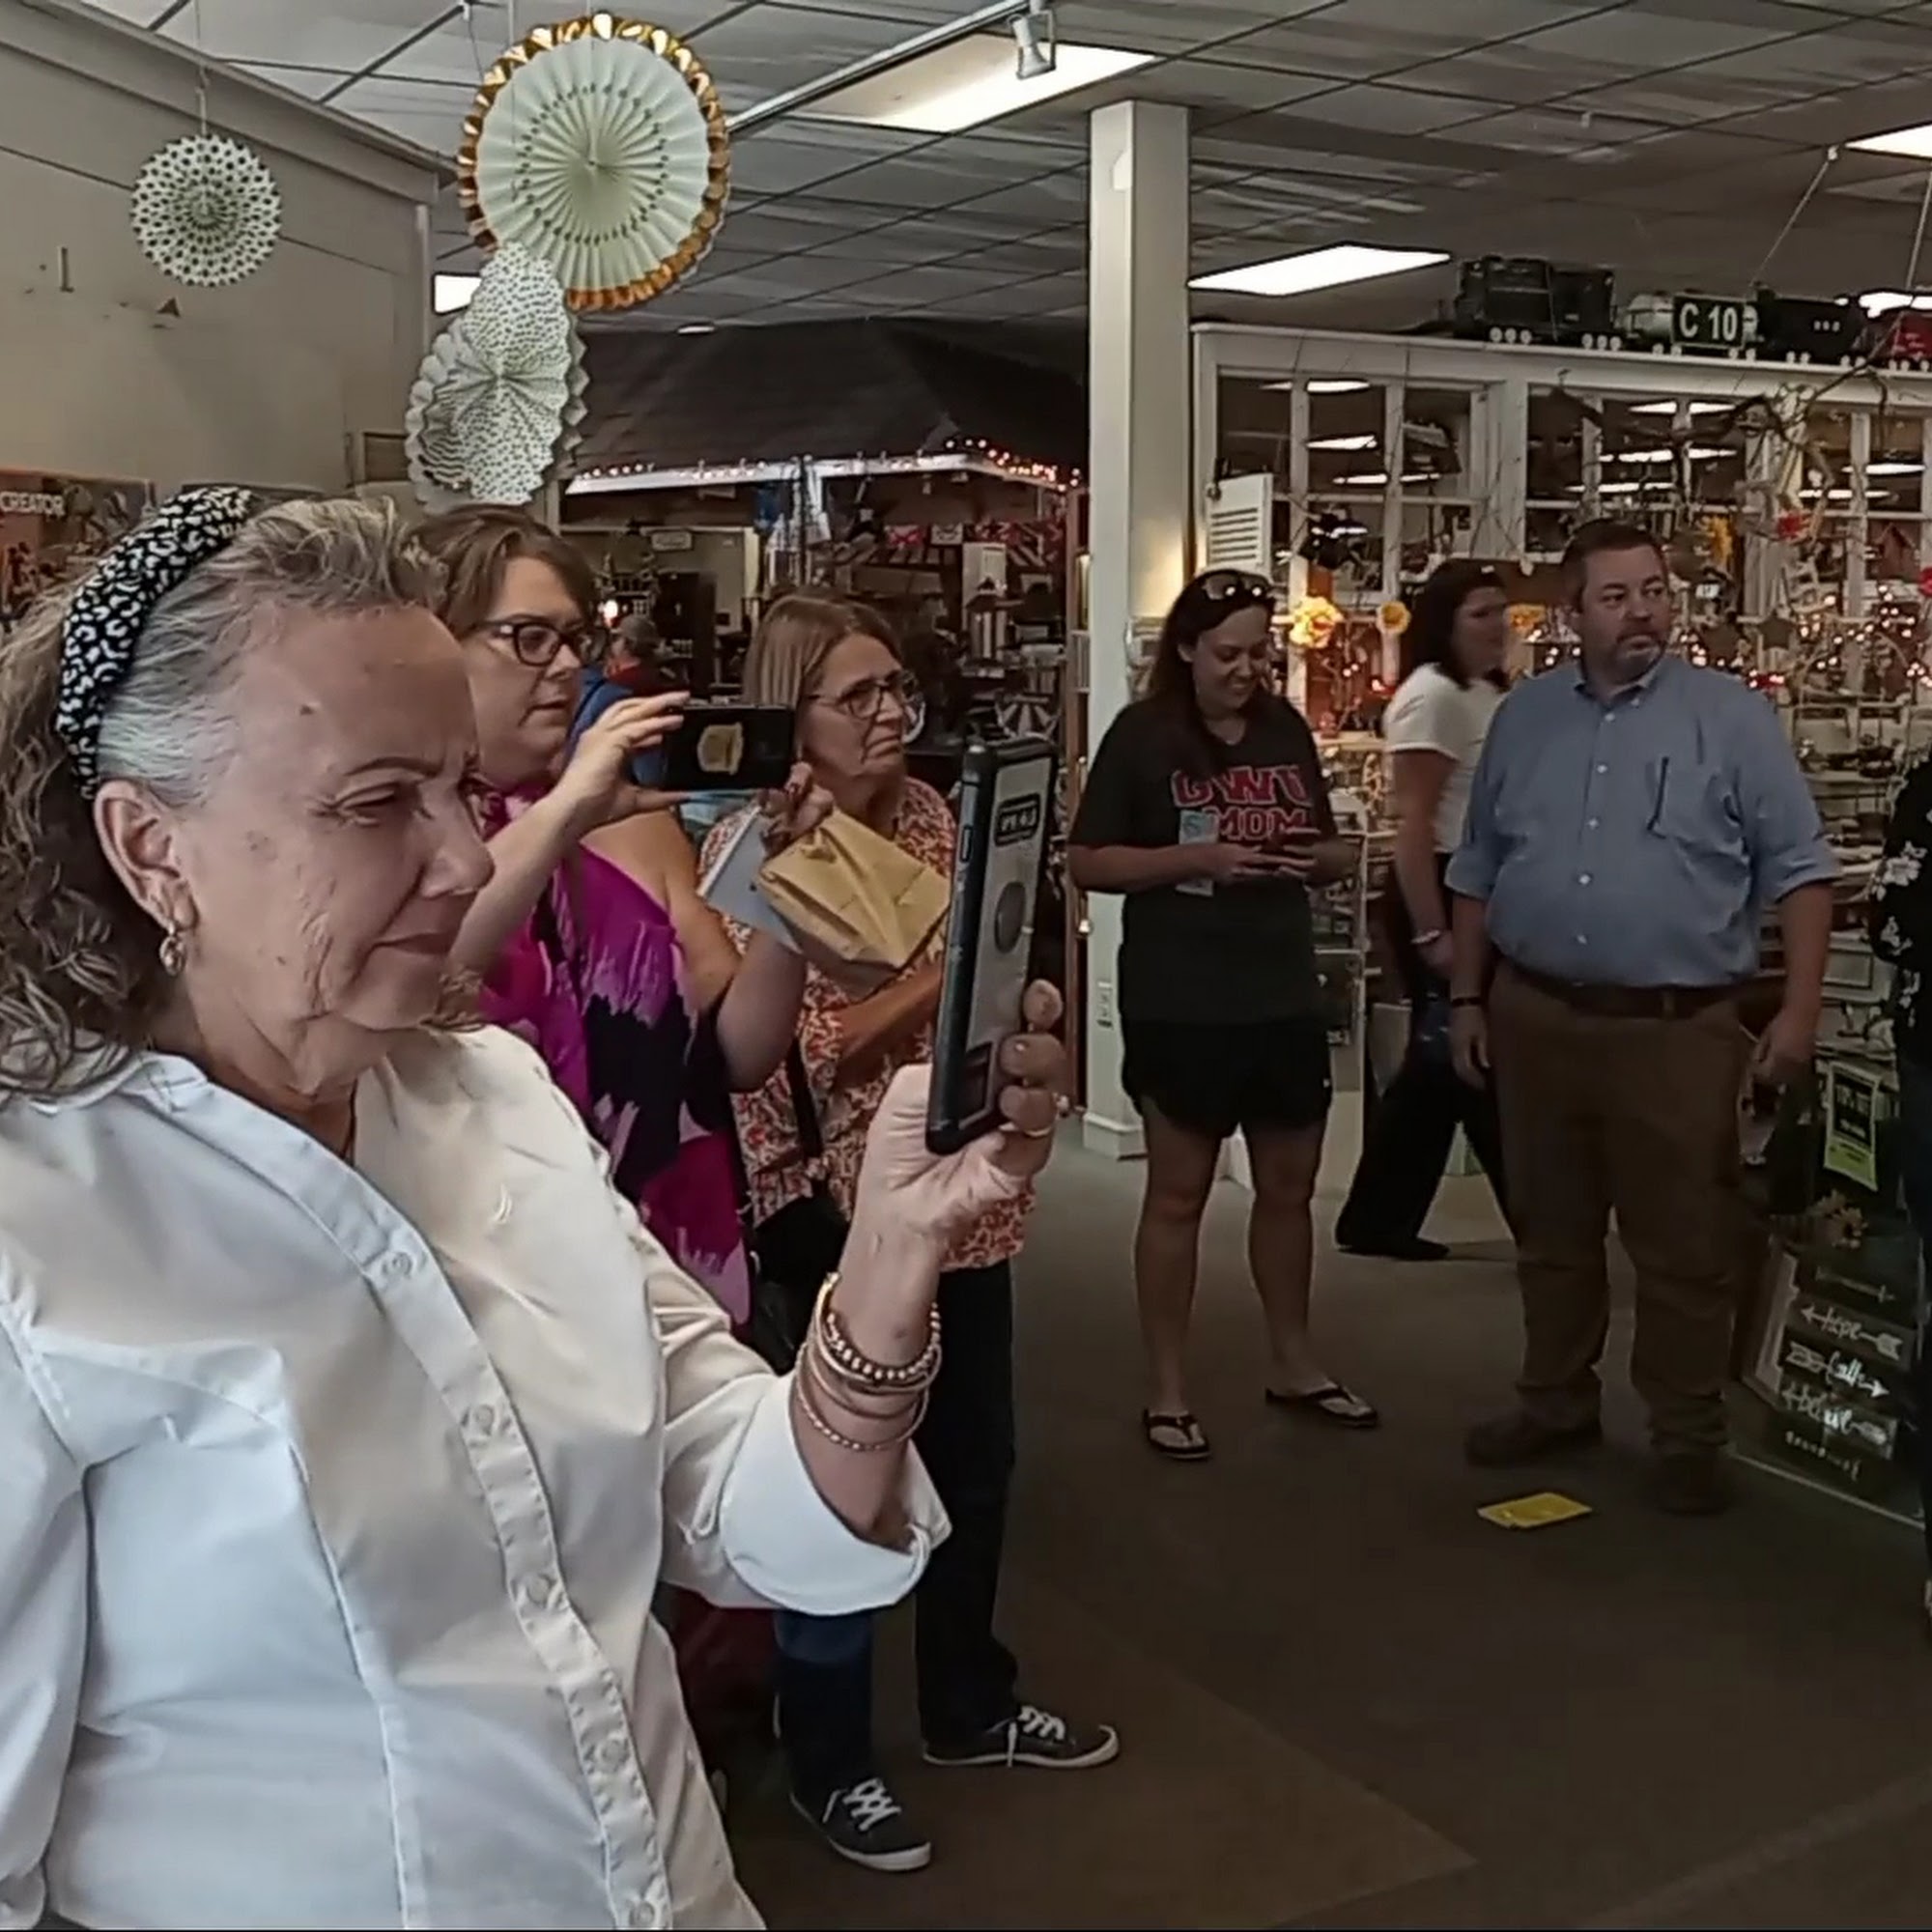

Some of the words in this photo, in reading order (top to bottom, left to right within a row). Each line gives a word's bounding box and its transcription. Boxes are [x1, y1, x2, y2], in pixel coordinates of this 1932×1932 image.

[1679, 302, 1699, 338] C
[1708, 304, 1738, 341] 10
[0, 491, 65, 517] CREATOR
[1201, 805, 1309, 840] MOM
